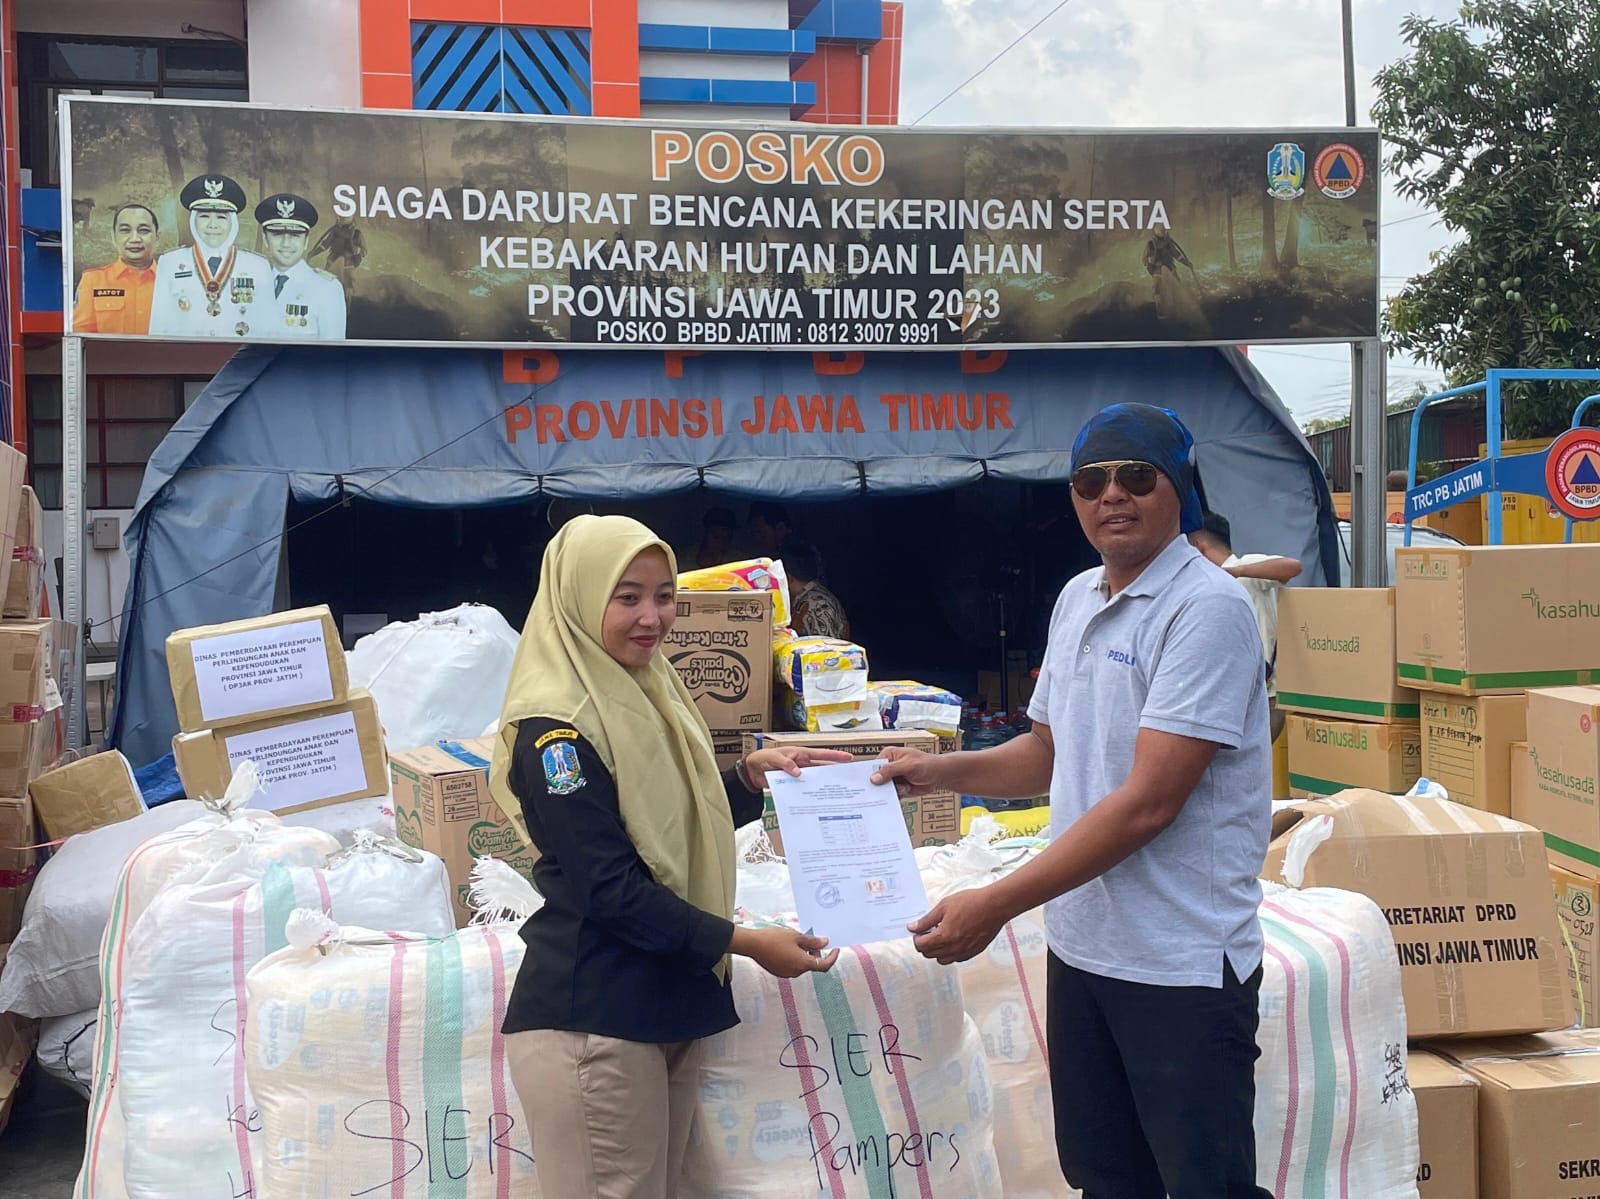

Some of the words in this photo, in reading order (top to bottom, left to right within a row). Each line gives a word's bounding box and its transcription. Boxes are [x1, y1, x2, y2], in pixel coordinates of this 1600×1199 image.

[651, 129, 885, 186] POSKO
[333, 184, 452, 220] SIAGA
[462, 188, 637, 226] DARURAT
[649, 194, 821, 229] BENCANA
[831, 198, 1053, 230] KEKERINGAN
[1063, 198, 1171, 230] SERTA
[480, 236, 707, 273] KEBAKARAN
[721, 241, 835, 275] HUTAN
[847, 243, 917, 275] DAN
[929, 243, 1042, 275] LAHAN
[527, 284, 695, 318] PROVINSI
[706, 287, 803, 319] JAWA
[811, 288, 917, 320] TIMUR
[597, 320, 667, 343] POSKO
[678, 321, 731, 344] BPBD
[736, 322, 790, 344] JATIM
[807, 322, 849, 344] 0812
[853, 322, 895, 344] 3007
[899, 322, 939, 344] 9991
[505, 397, 723, 444] PROVINSI
[740, 394, 865, 434] JAWA
[880, 392, 1014, 432] TIMUR
[1411, 493, 1433, 511] TRC
[1435, 484, 1450, 503] PB
[1452, 471, 1483, 497] JATIM
[1575, 485, 1597, 494] BPBD
[194, 653, 217, 662] DINAS
[220, 643, 278, 658] PEMBERDAYAAN
[279, 636, 322, 649] PEREMPUAN
[712, 631, 748, 647] X-tra
[212, 653, 269, 667] PERLINDUNGAN
[271, 649, 289, 658] ANAK
[291, 647, 306, 655] DAN
[231, 657, 289, 671] KEPENDUDUKAN
[690, 656, 724, 669] pants
[221, 671, 257, 682] PROVINSI
[257, 668, 278, 677] JAWA
[279, 664, 302, 673] TIMUR
[276, 673, 298, 682] JATIM
[675, 665, 745, 694] MamyPok
[229, 750, 252, 759] DINAS
[255, 737, 311, 753] PEMBERDAYAAN
[312, 728, 354, 741] PEREMPUAN
[304, 742, 322, 750] ANAK
[324, 739, 339, 747] DAN
[267, 750, 323, 766] KEPENDUDUKAN
[292, 761, 312, 770] JAWA
[313, 756, 336, 765] TIMUR
[311, 765, 332, 774] JATIM
[1381, 905, 1465, 925] KRETARIAT
[1476, 903, 1516, 922] DPRD
[1435, 940, 1482, 965] JAWA
[1483, 937, 1539, 962] TIMUR
[779, 1023, 922, 1099] SIER
[343, 1099, 535, 1197] SIER
[808, 1111, 960, 1199] Pampers
